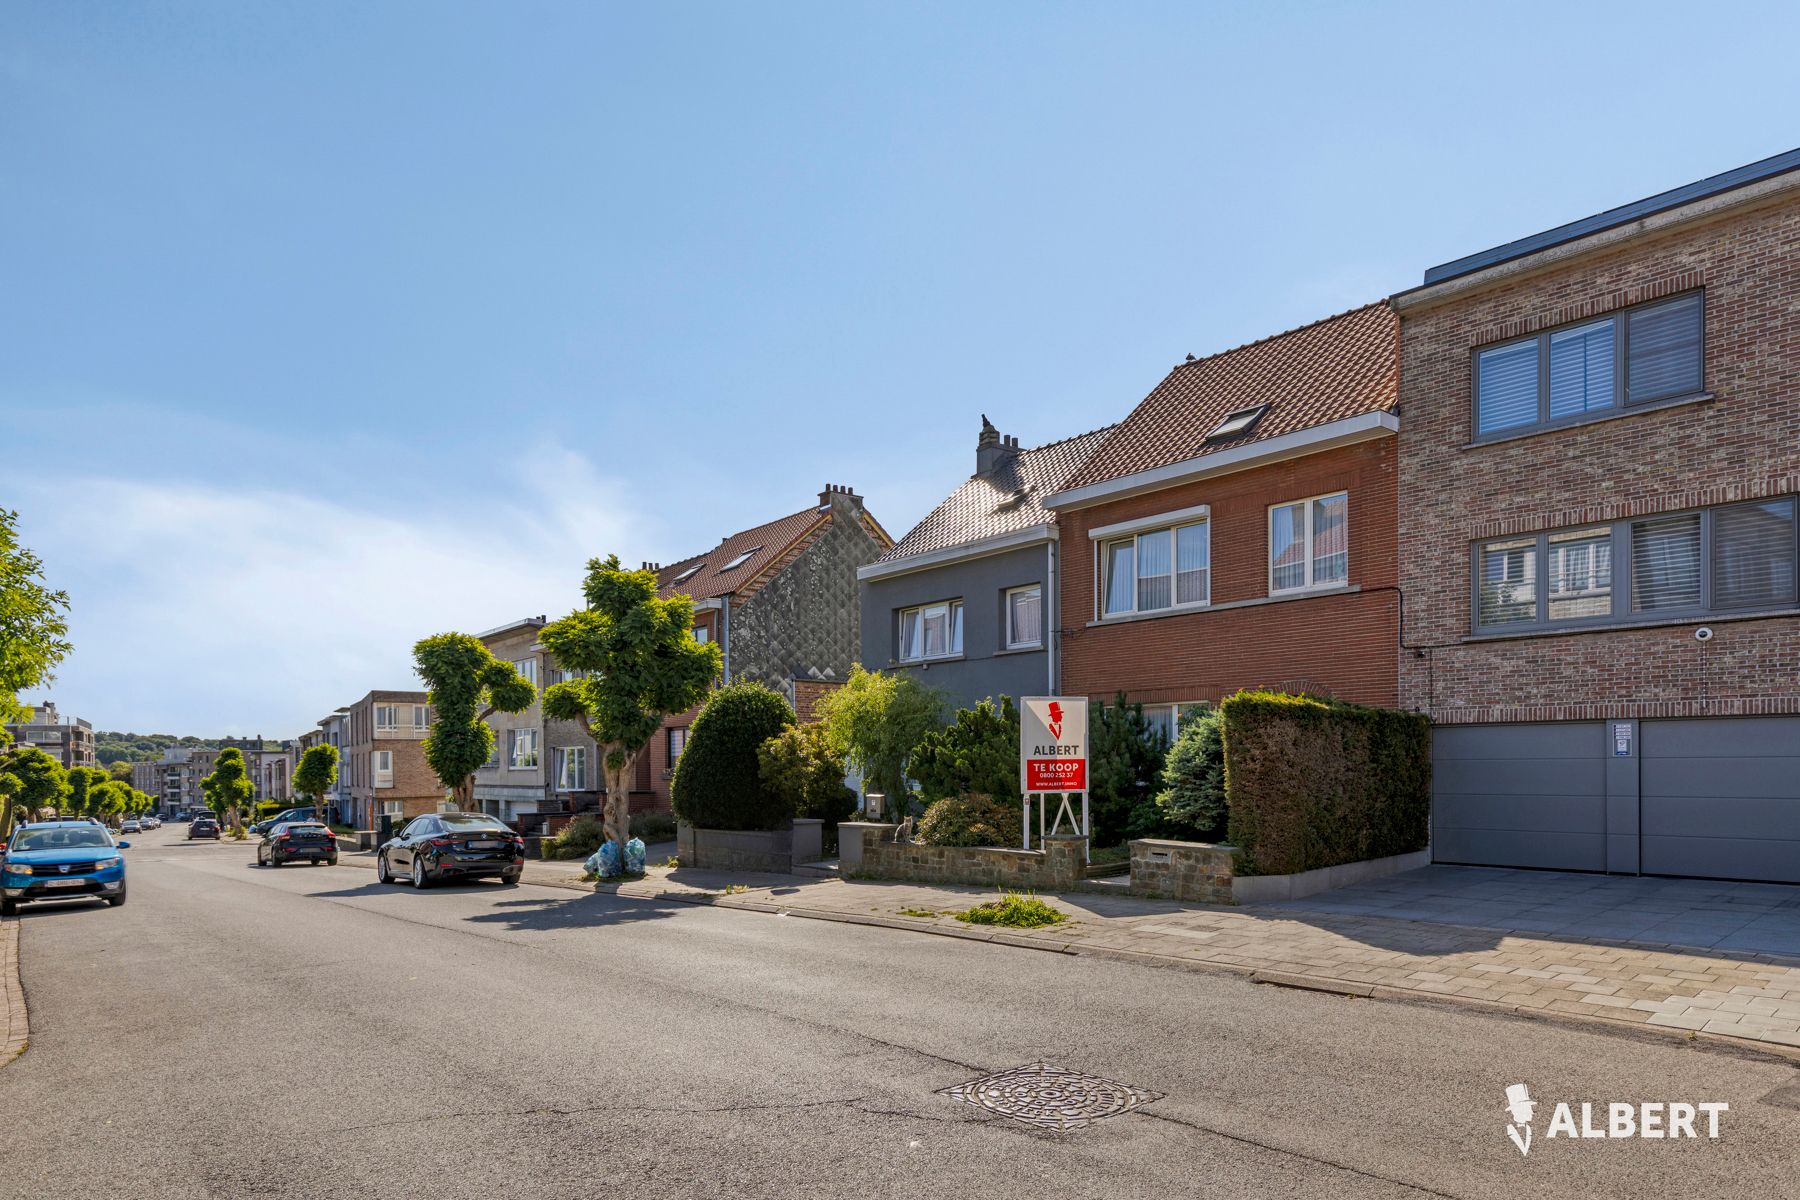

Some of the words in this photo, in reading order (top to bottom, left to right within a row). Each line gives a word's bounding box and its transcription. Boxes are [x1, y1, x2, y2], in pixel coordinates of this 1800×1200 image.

[1033, 745, 1079, 756] ALBERT
[1033, 763, 1046, 772] TE
[1049, 763, 1079, 772] KOOP
